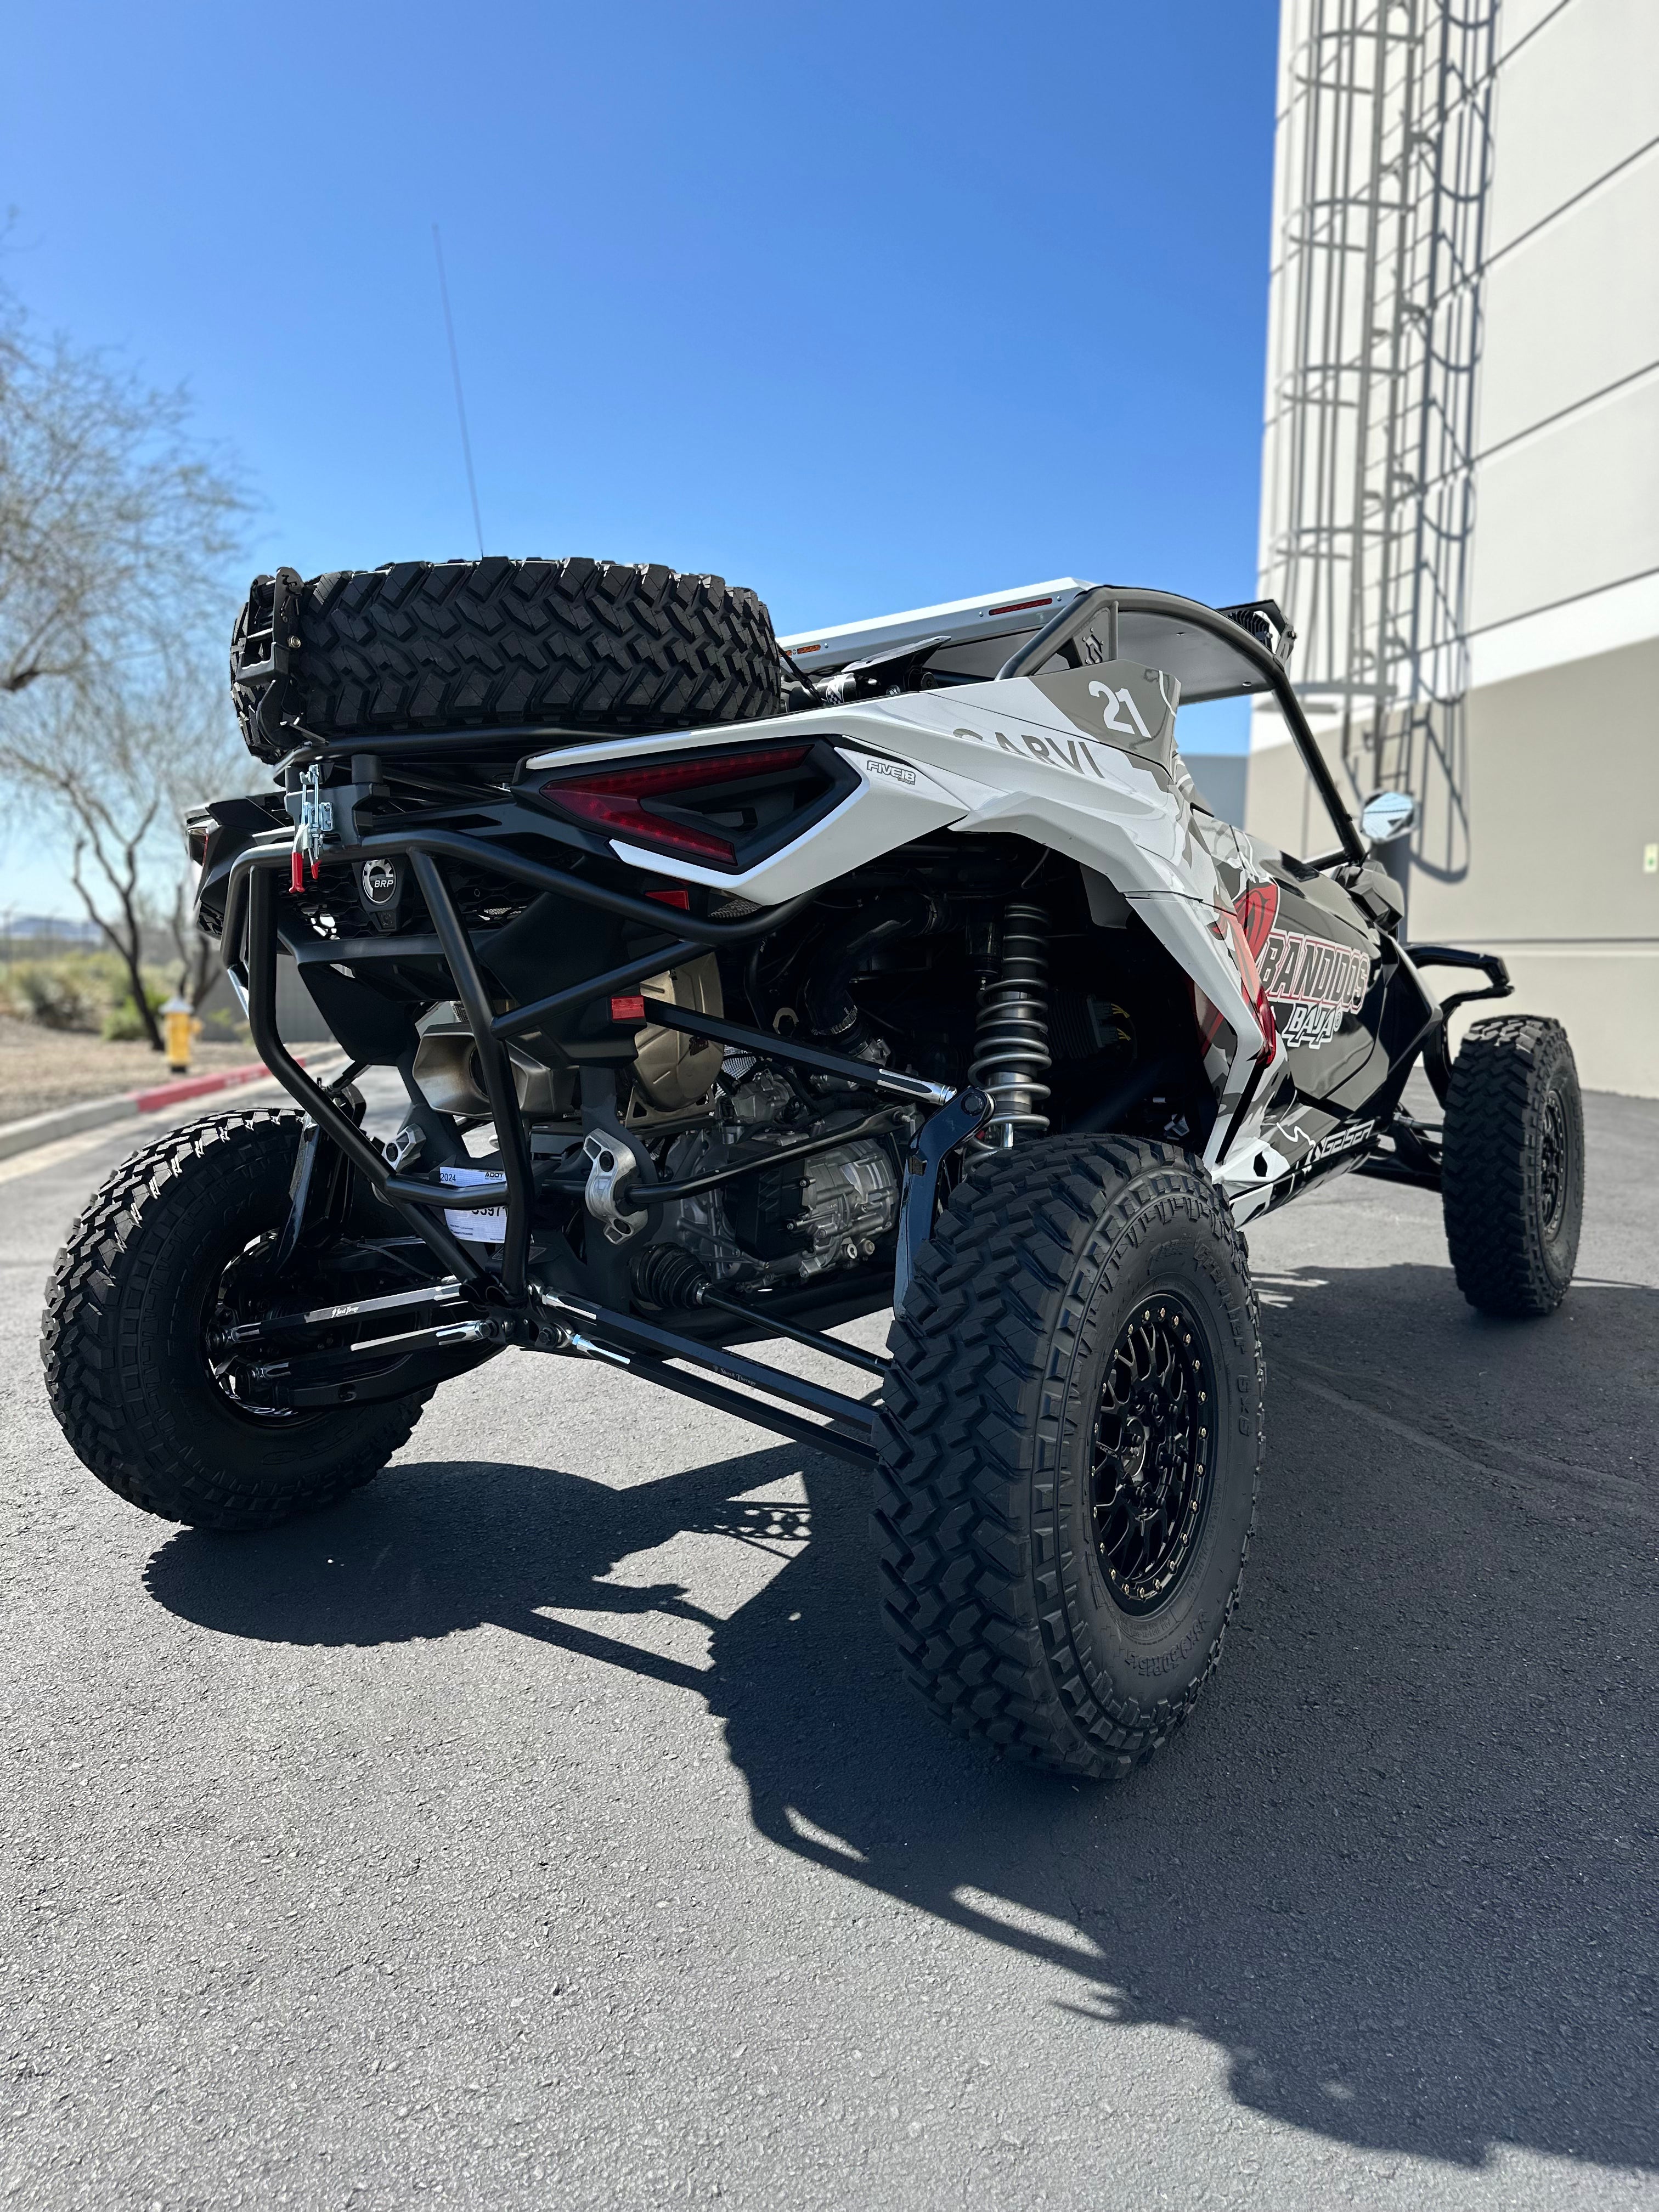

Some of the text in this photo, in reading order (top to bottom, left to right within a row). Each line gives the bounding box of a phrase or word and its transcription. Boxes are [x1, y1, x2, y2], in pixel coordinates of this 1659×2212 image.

[1088, 680, 1152, 738] 21
[953, 728, 1105, 778] ARVI
[374, 879, 394, 888] BRP
[1261, 934, 1370, 1011] BANDIDOS
[440, 1173, 456, 1182] 2024
